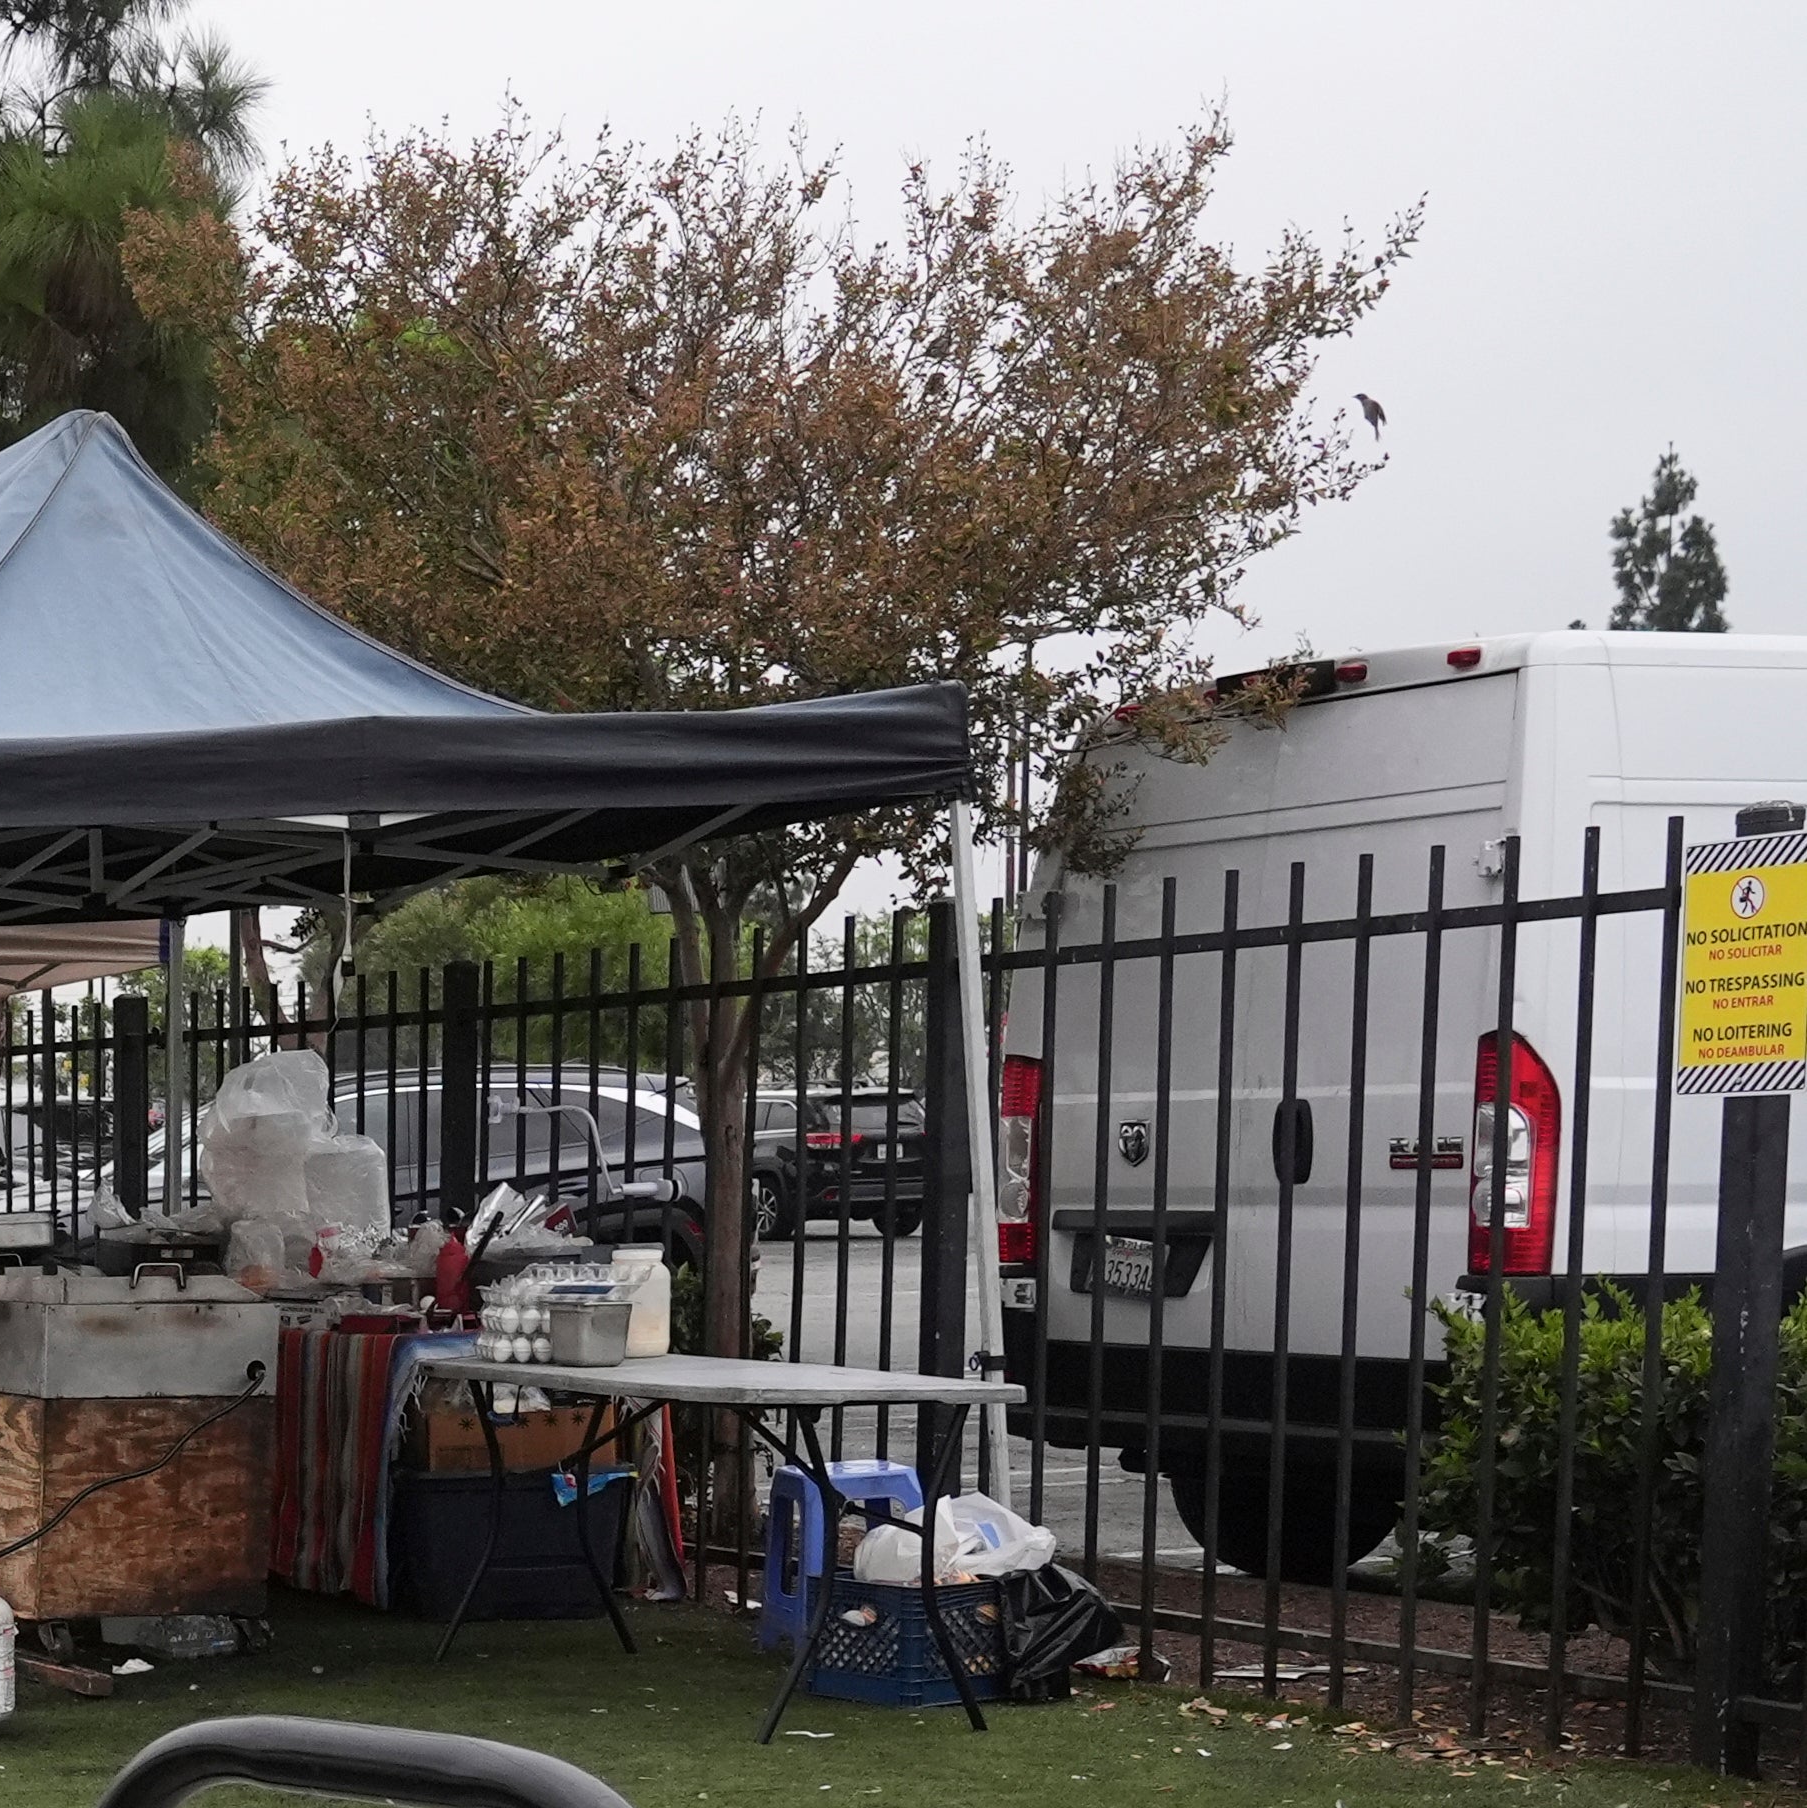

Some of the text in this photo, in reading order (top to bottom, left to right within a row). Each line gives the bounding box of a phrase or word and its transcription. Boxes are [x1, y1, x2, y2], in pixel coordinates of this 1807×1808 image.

[1686, 921, 1807, 946] NO SOLICITATION
[1709, 944, 1782, 960] NO SOLICITAR
[1685, 972, 1805, 995] NO TRESPASSING
[1713, 995, 1774, 1010] NO ENTRAR
[1693, 1022, 1792, 1042] NO LOITERING
[1698, 1044, 1785, 1059] NO DEAMBULAR
[1104, 1260, 1153, 1294] 3533A
